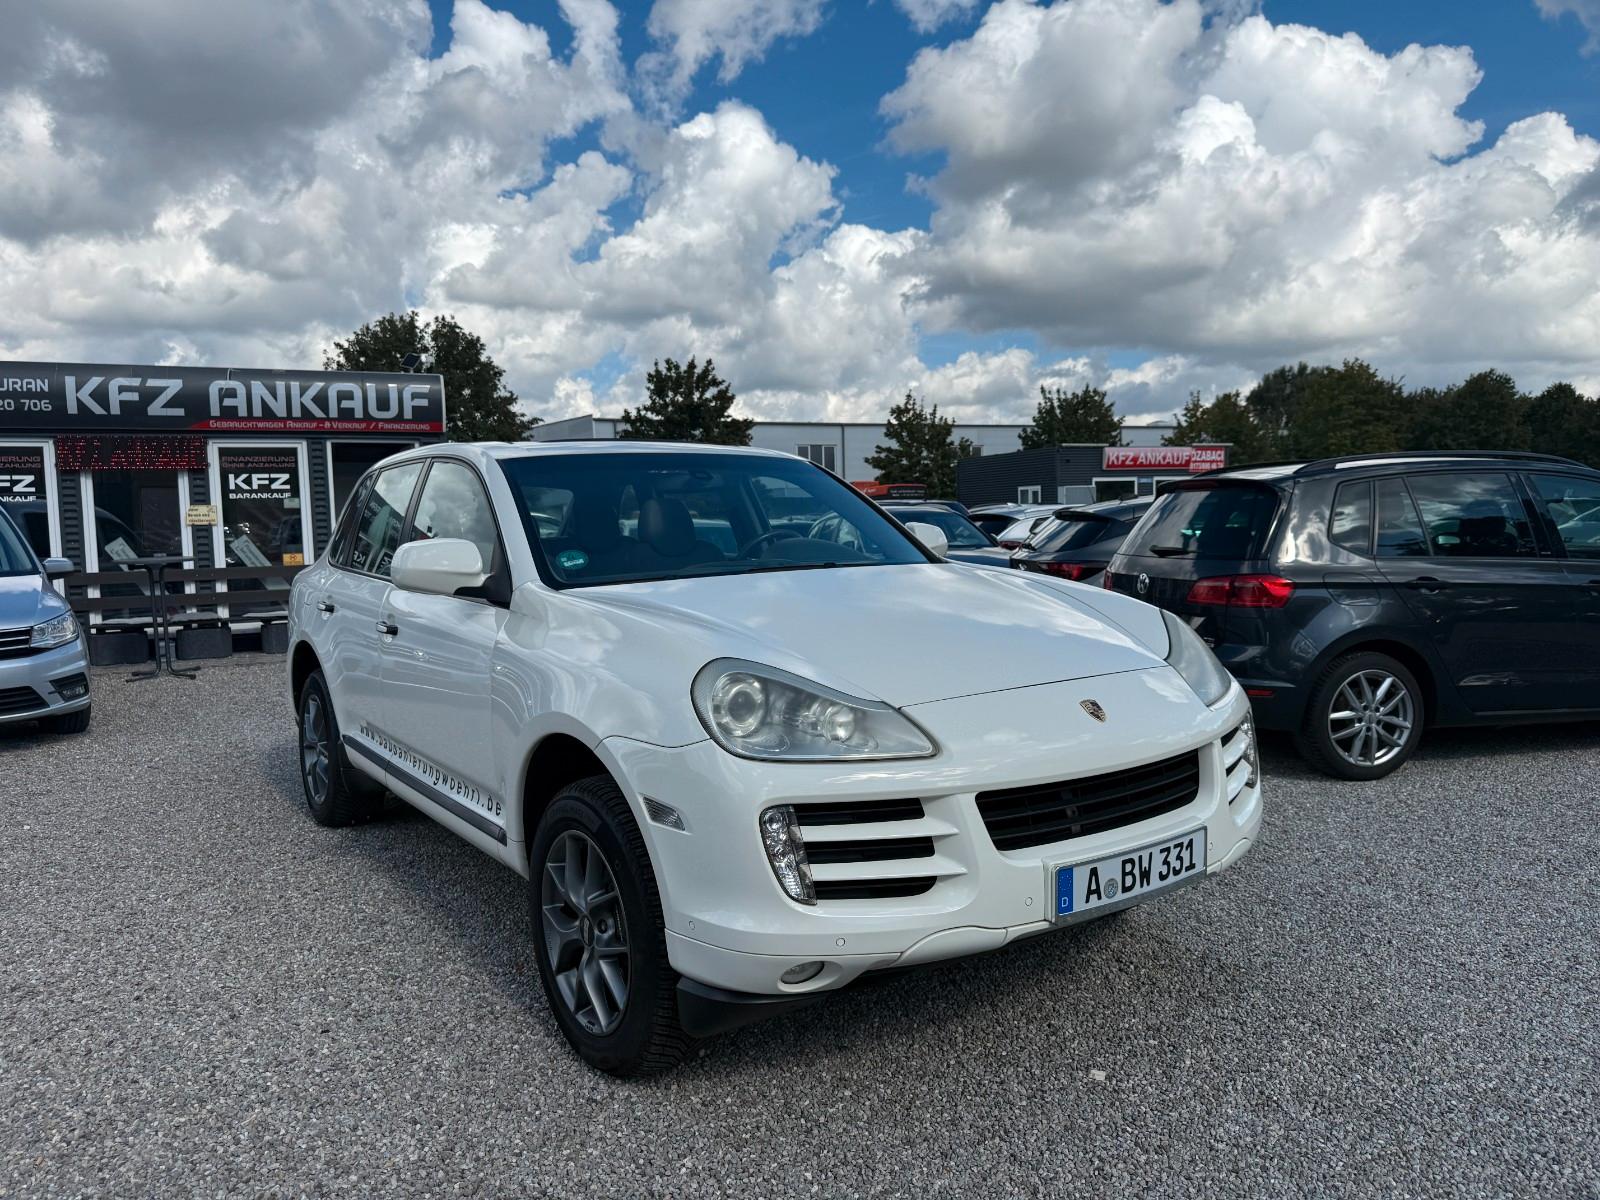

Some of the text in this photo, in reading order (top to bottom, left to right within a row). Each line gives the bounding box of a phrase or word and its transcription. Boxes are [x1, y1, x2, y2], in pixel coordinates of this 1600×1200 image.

[65, 376, 431, 419] KFZ ANKAUF
[20, 399, 53, 412] 706
[1108, 451, 1190, 465] KFZ ANKAUF
[228, 473, 291, 490] KFZ
[229, 492, 292, 500] BARANKAUF
[1085, 838, 1196, 904] A BW 331
[1061, 897, 1069, 907] D
